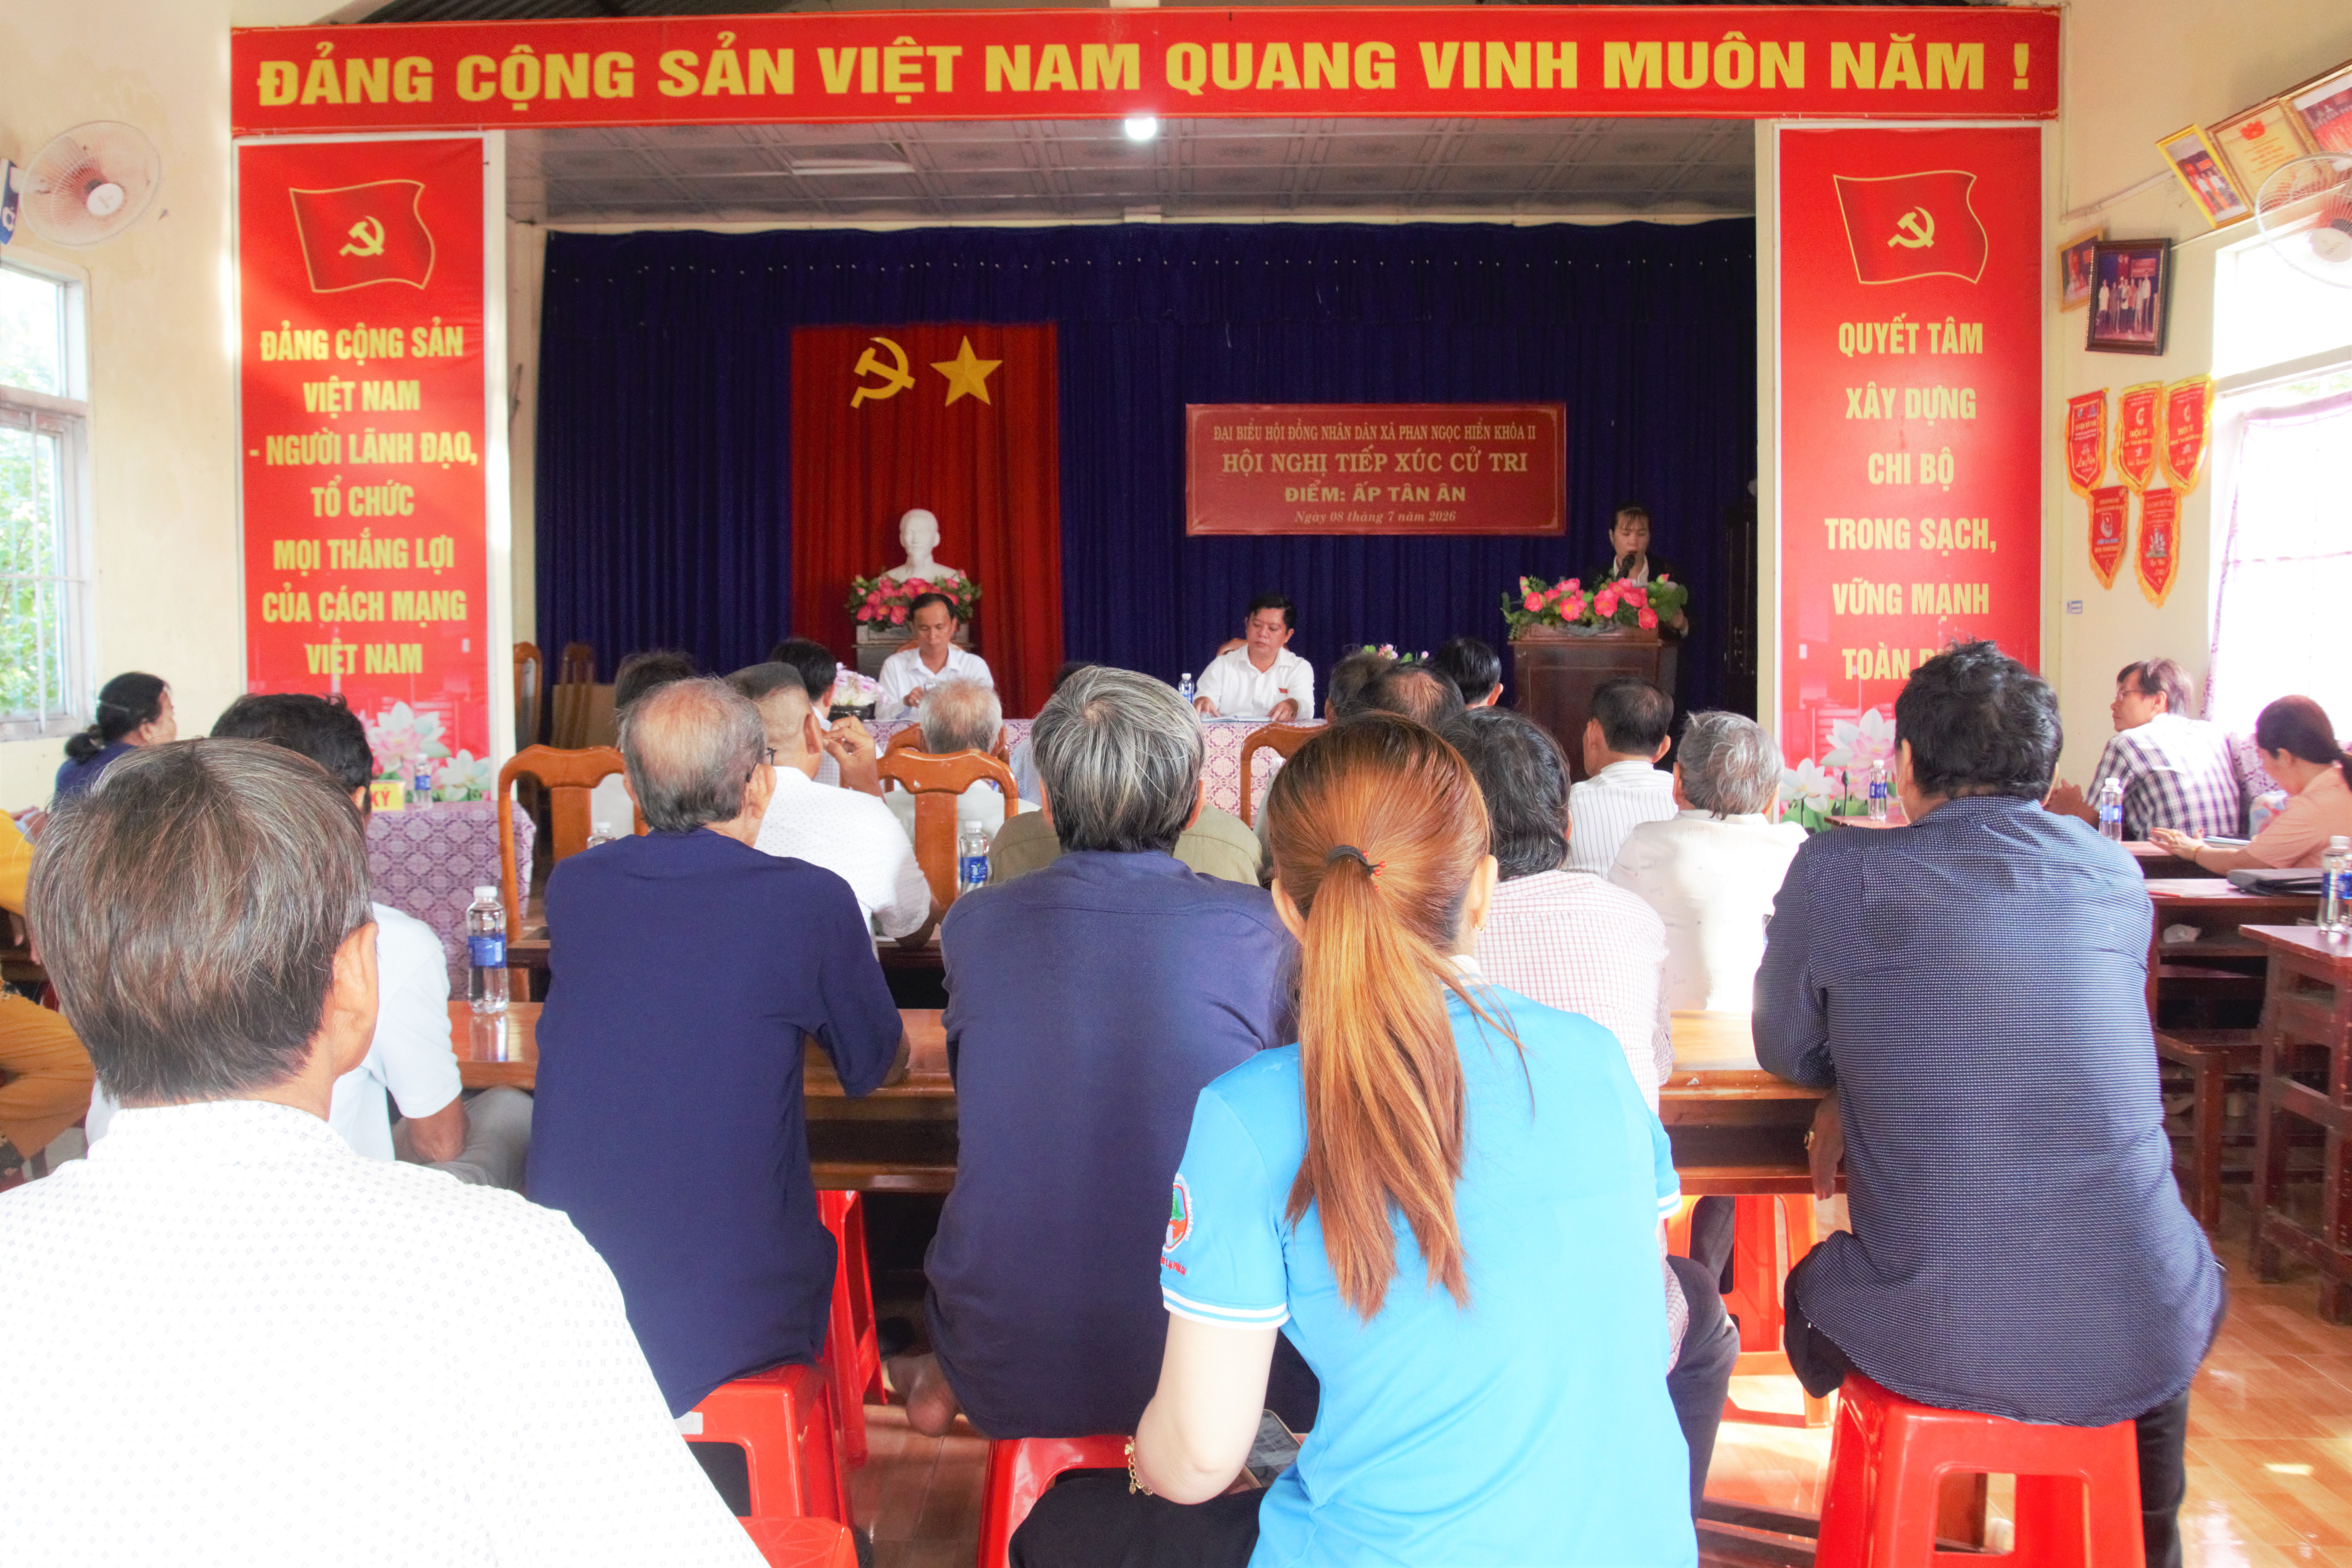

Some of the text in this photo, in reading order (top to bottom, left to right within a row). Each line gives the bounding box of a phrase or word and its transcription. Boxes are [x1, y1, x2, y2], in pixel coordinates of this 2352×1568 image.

[257, 32, 2028, 110] ĐẢNG CỘNG SẢN VIỆT NAM QUANG VINH MUÔN NĂM !
[260, 317, 463, 366] ĐẢNG CỘNG SẢN
[1839, 313, 1982, 357] QUYẾT TÂM
[303, 375, 419, 419] VIỆT NAM
[1846, 382, 1975, 426] XÂY DỰNG
[267, 427, 341, 465] NGƯỜI
[349, 428, 413, 463] LÃNH
[420, 432, 477, 469] ĐẠO,
[1214, 417, 1536, 443] ĐẠI BIỂU HỘI ĐỒNG NHÂN DÂN XÃ PHAN NGỌC HIỂN KHÓA II
[1223, 445, 1527, 477] HỘI NGHỊ TIẾP XÚC CỬ TRI
[1868, 447, 1954, 491] CHI BỘ
[311, 475, 414, 517] TỔ CHỨC
[1285, 480, 1465, 502] ĐIỂM: ẤP TÂN ÂN
[1295, 511, 1456, 524] Ngày 08 tháng 7 năm 2026
[1825, 518, 1996, 556] TRONG SẠCH,
[274, 528, 453, 576] MỌI THẮNG LỢI
[263, 583, 466, 627] CỦA CÁCH MẠNG
[1833, 578, 1989, 621] VỮNG MẠNH
[306, 638, 422, 680] VIỆT NAM
[1842, 642, 1909, 680] TOÀN
